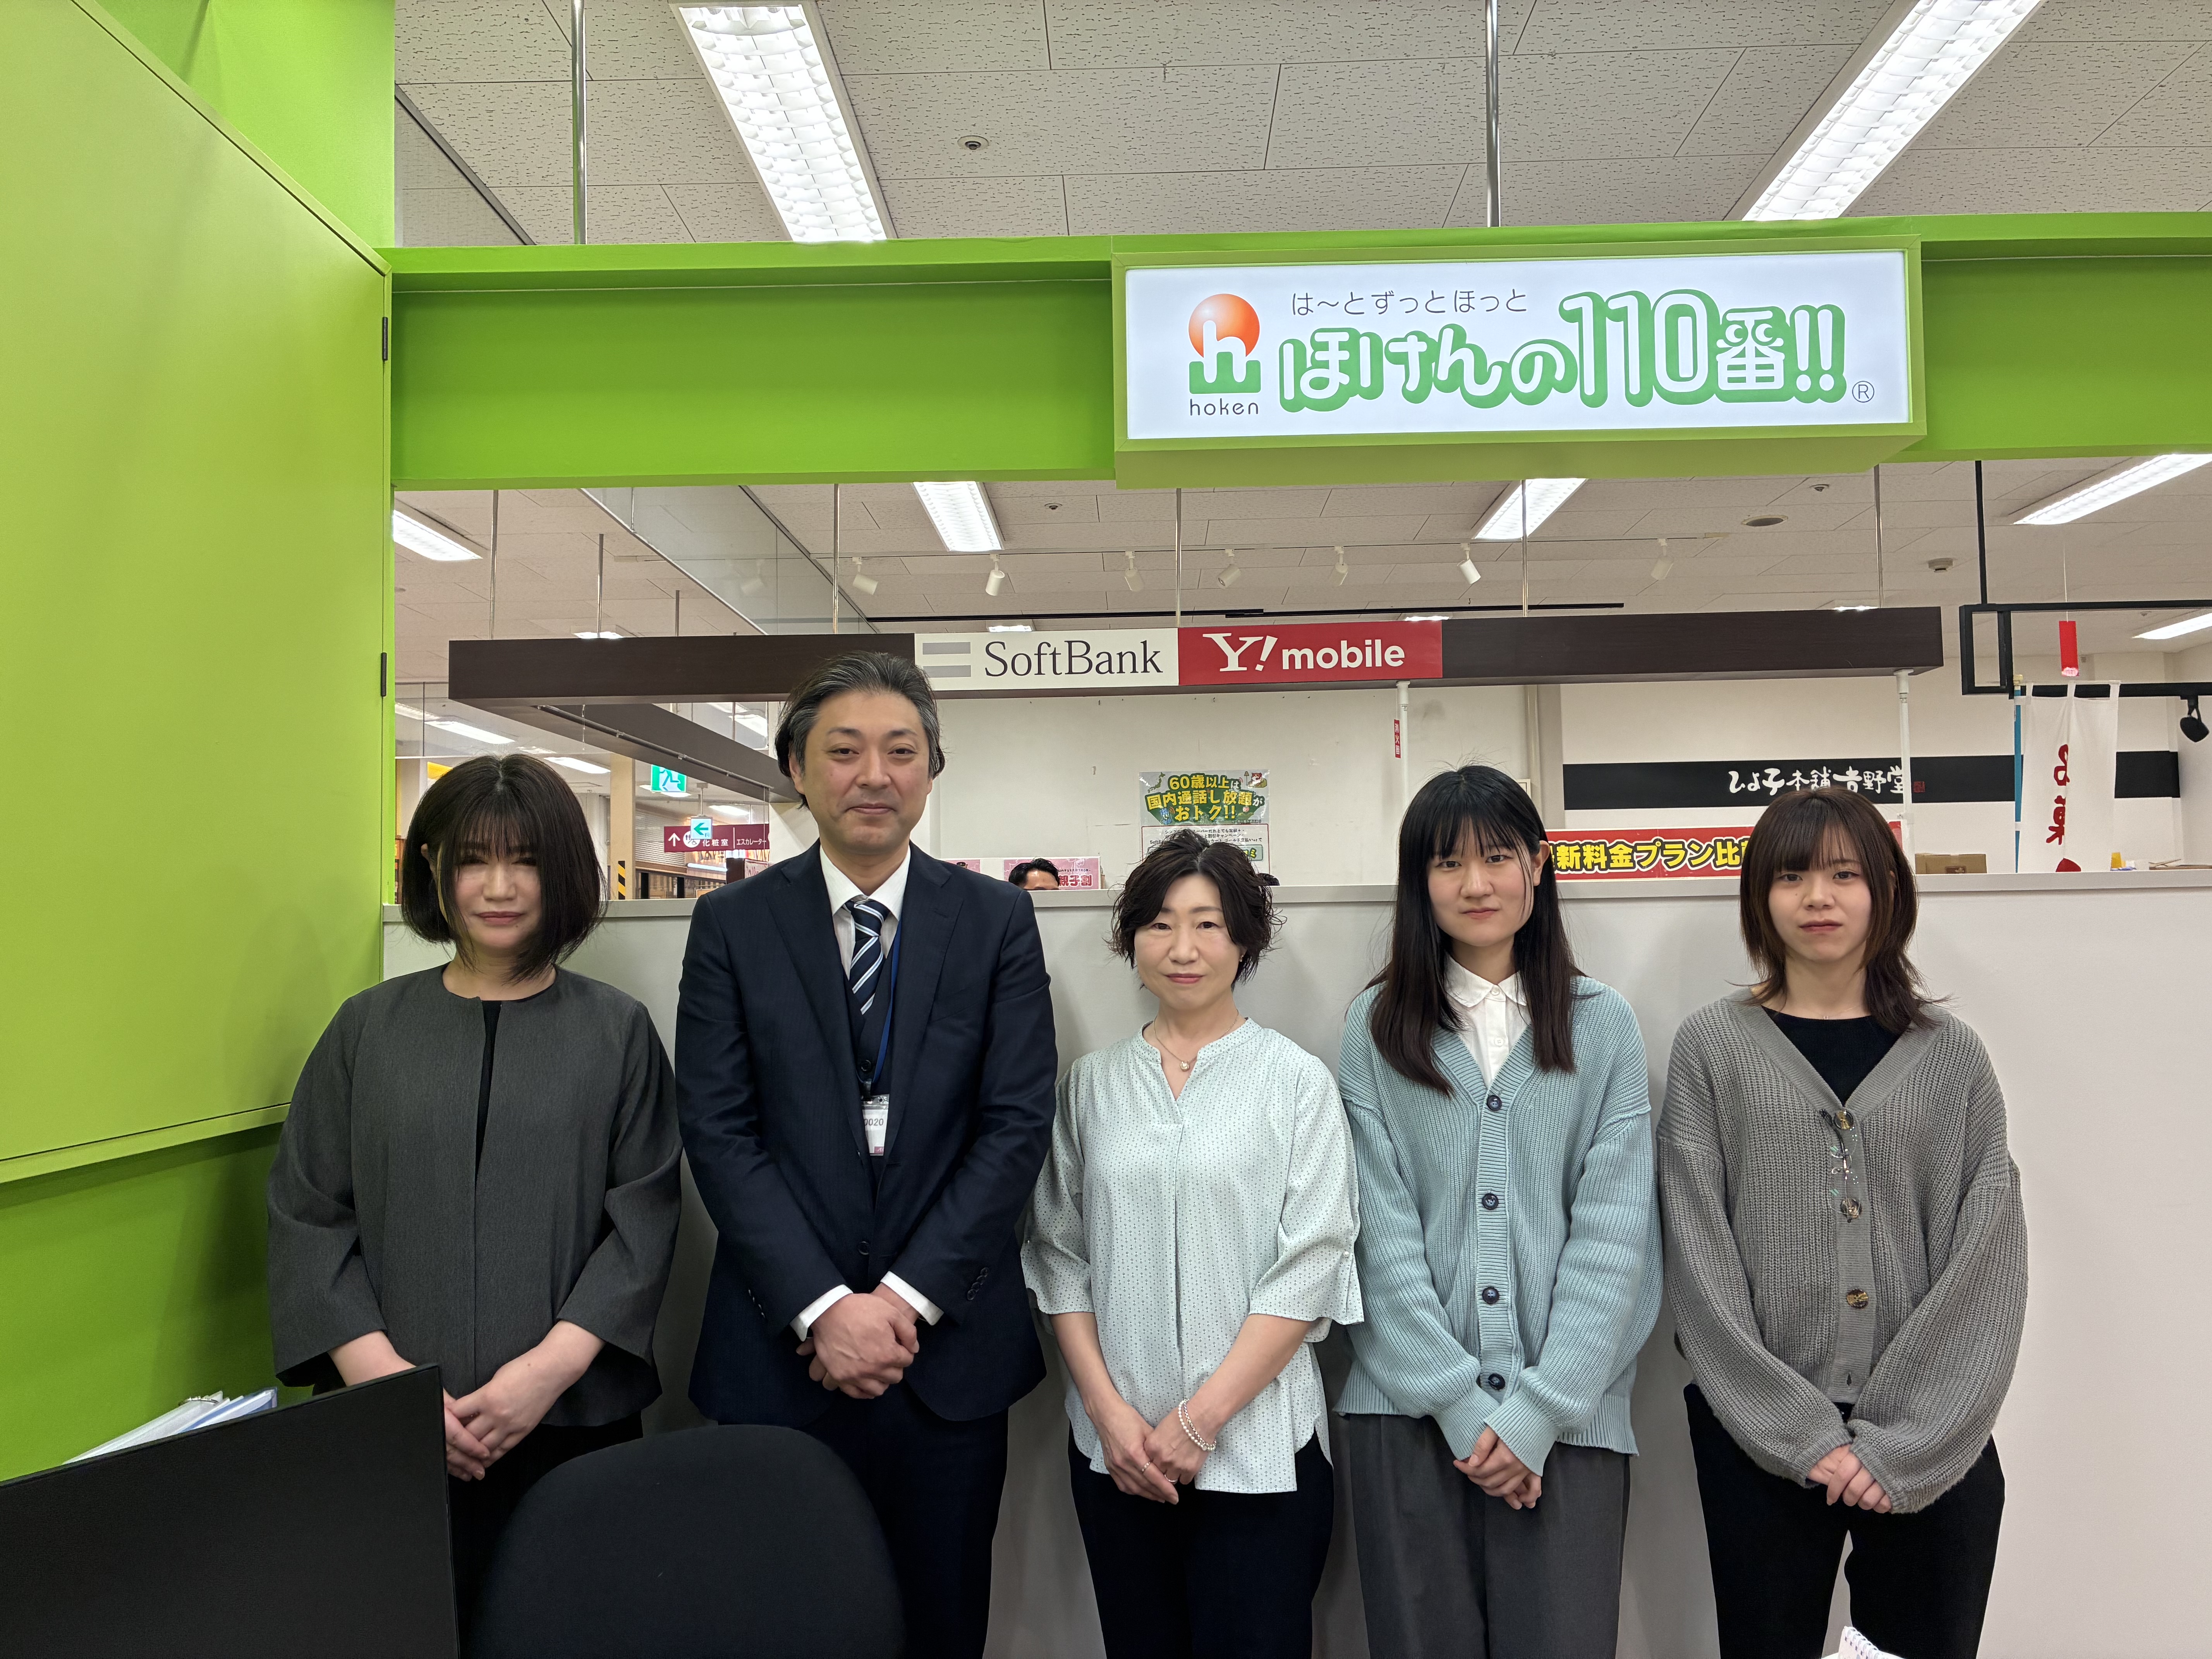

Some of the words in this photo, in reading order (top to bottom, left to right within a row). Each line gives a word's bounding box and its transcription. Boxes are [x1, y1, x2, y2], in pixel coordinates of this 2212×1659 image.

[1190, 398, 1259, 416] hoken
[985, 640, 1163, 677] SoftBank
[1282, 639, 1405, 670] mobile
[1169, 774, 1240, 790] 60歳以上は
[1146, 790, 1263, 810] 国内通話し放題が
[1174, 805, 1235, 821] おトク!!
[702, 838, 729, 847] 化粧室
[1549, 841, 1747, 870] 新料金プラン比
